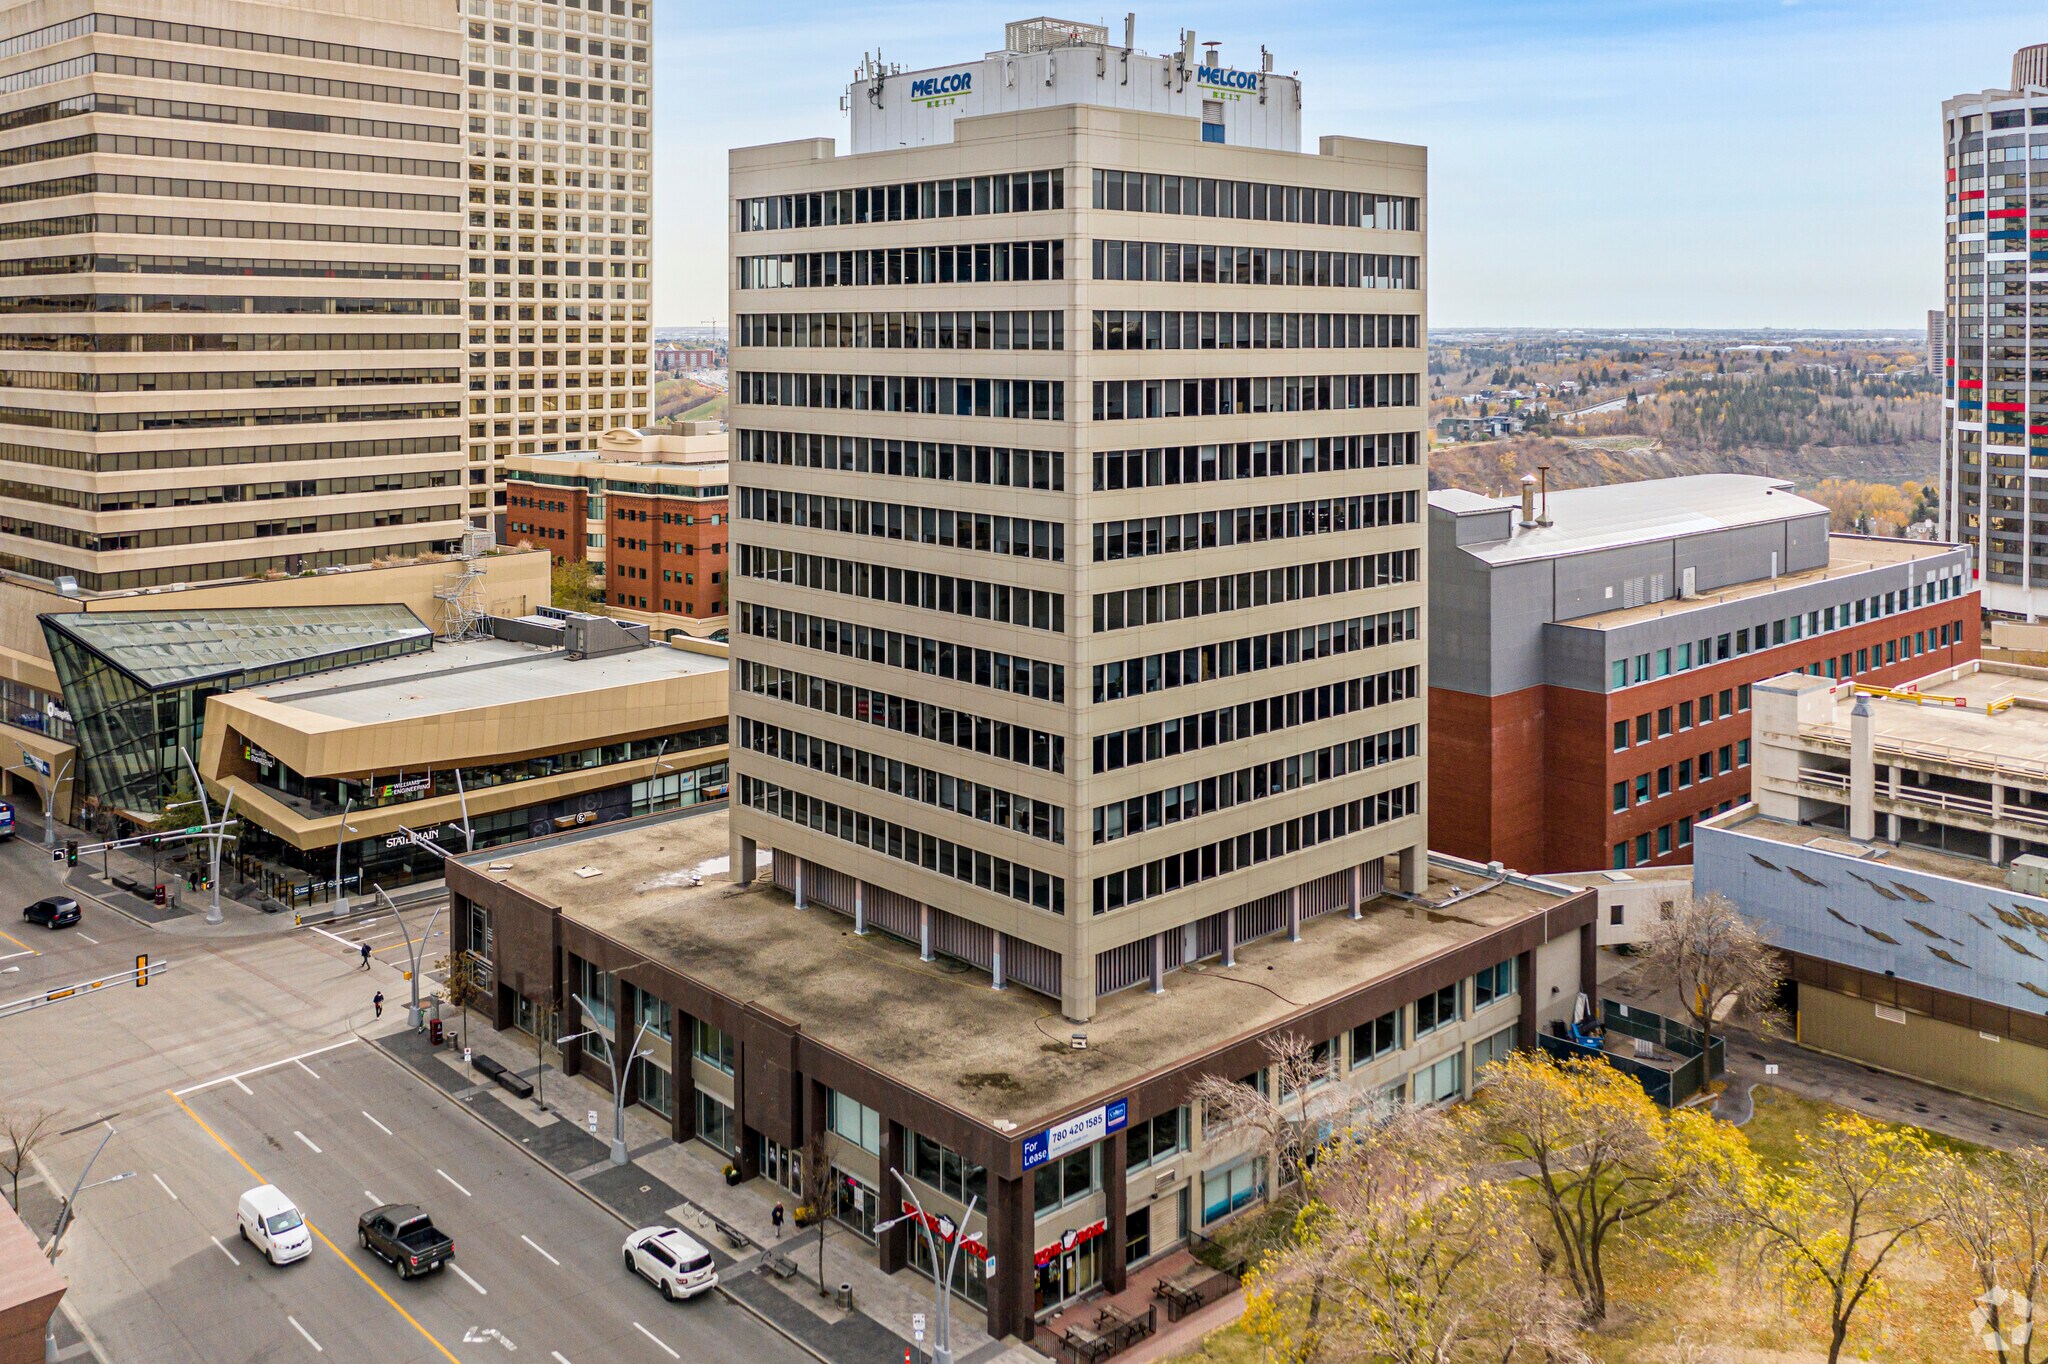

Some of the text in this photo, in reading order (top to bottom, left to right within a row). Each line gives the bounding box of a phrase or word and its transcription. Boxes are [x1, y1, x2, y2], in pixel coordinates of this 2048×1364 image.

[911, 72, 972, 98] MELCOR
[1197, 65, 1257, 90] MELCOR
[393, 779, 420, 789] WILLIAMS
[393, 783, 430, 795] ENGINEERING
[1052, 1129, 1068, 1143] 780
[1069, 1122, 1085, 1135] 420
[1086, 1114, 1103, 1129] 1585
[1024, 1141, 1039, 1155] For
[1024, 1149, 1047, 1167] Lease
[1076, 1219, 1106, 1245] BOX
